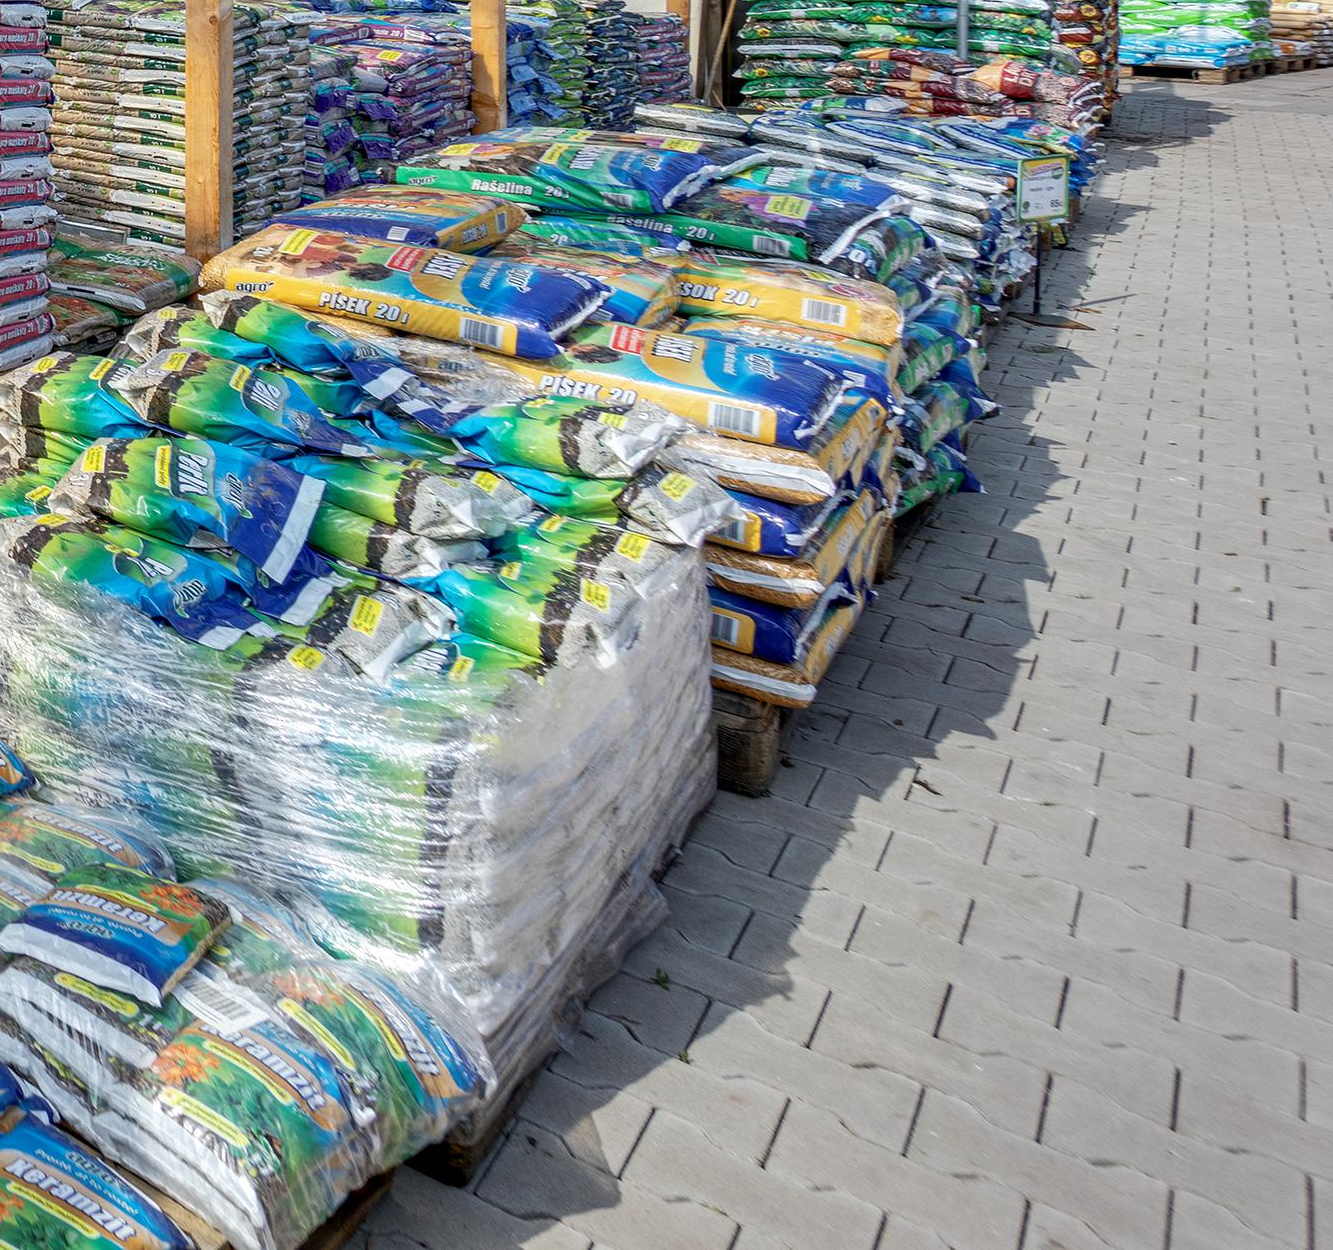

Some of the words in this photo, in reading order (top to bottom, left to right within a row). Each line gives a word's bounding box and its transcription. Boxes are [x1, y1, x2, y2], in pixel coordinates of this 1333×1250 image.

[471, 178, 532, 196] Rašelina
[544, 185, 562, 199] 20
[607, 214, 674, 234] Rašelina
[687, 225, 706, 239] 20
[236, 281, 266, 293] agro
[318, 291, 369, 315] PÍSEK
[376, 304, 400, 321] 20
[723, 288, 748, 306] 20
[539, 375, 602, 401] PÍSEK
[610, 388, 637, 404] 20
[52, 886, 168, 935] Keramzit
[4, 1157, 136, 1241] Keramzit
